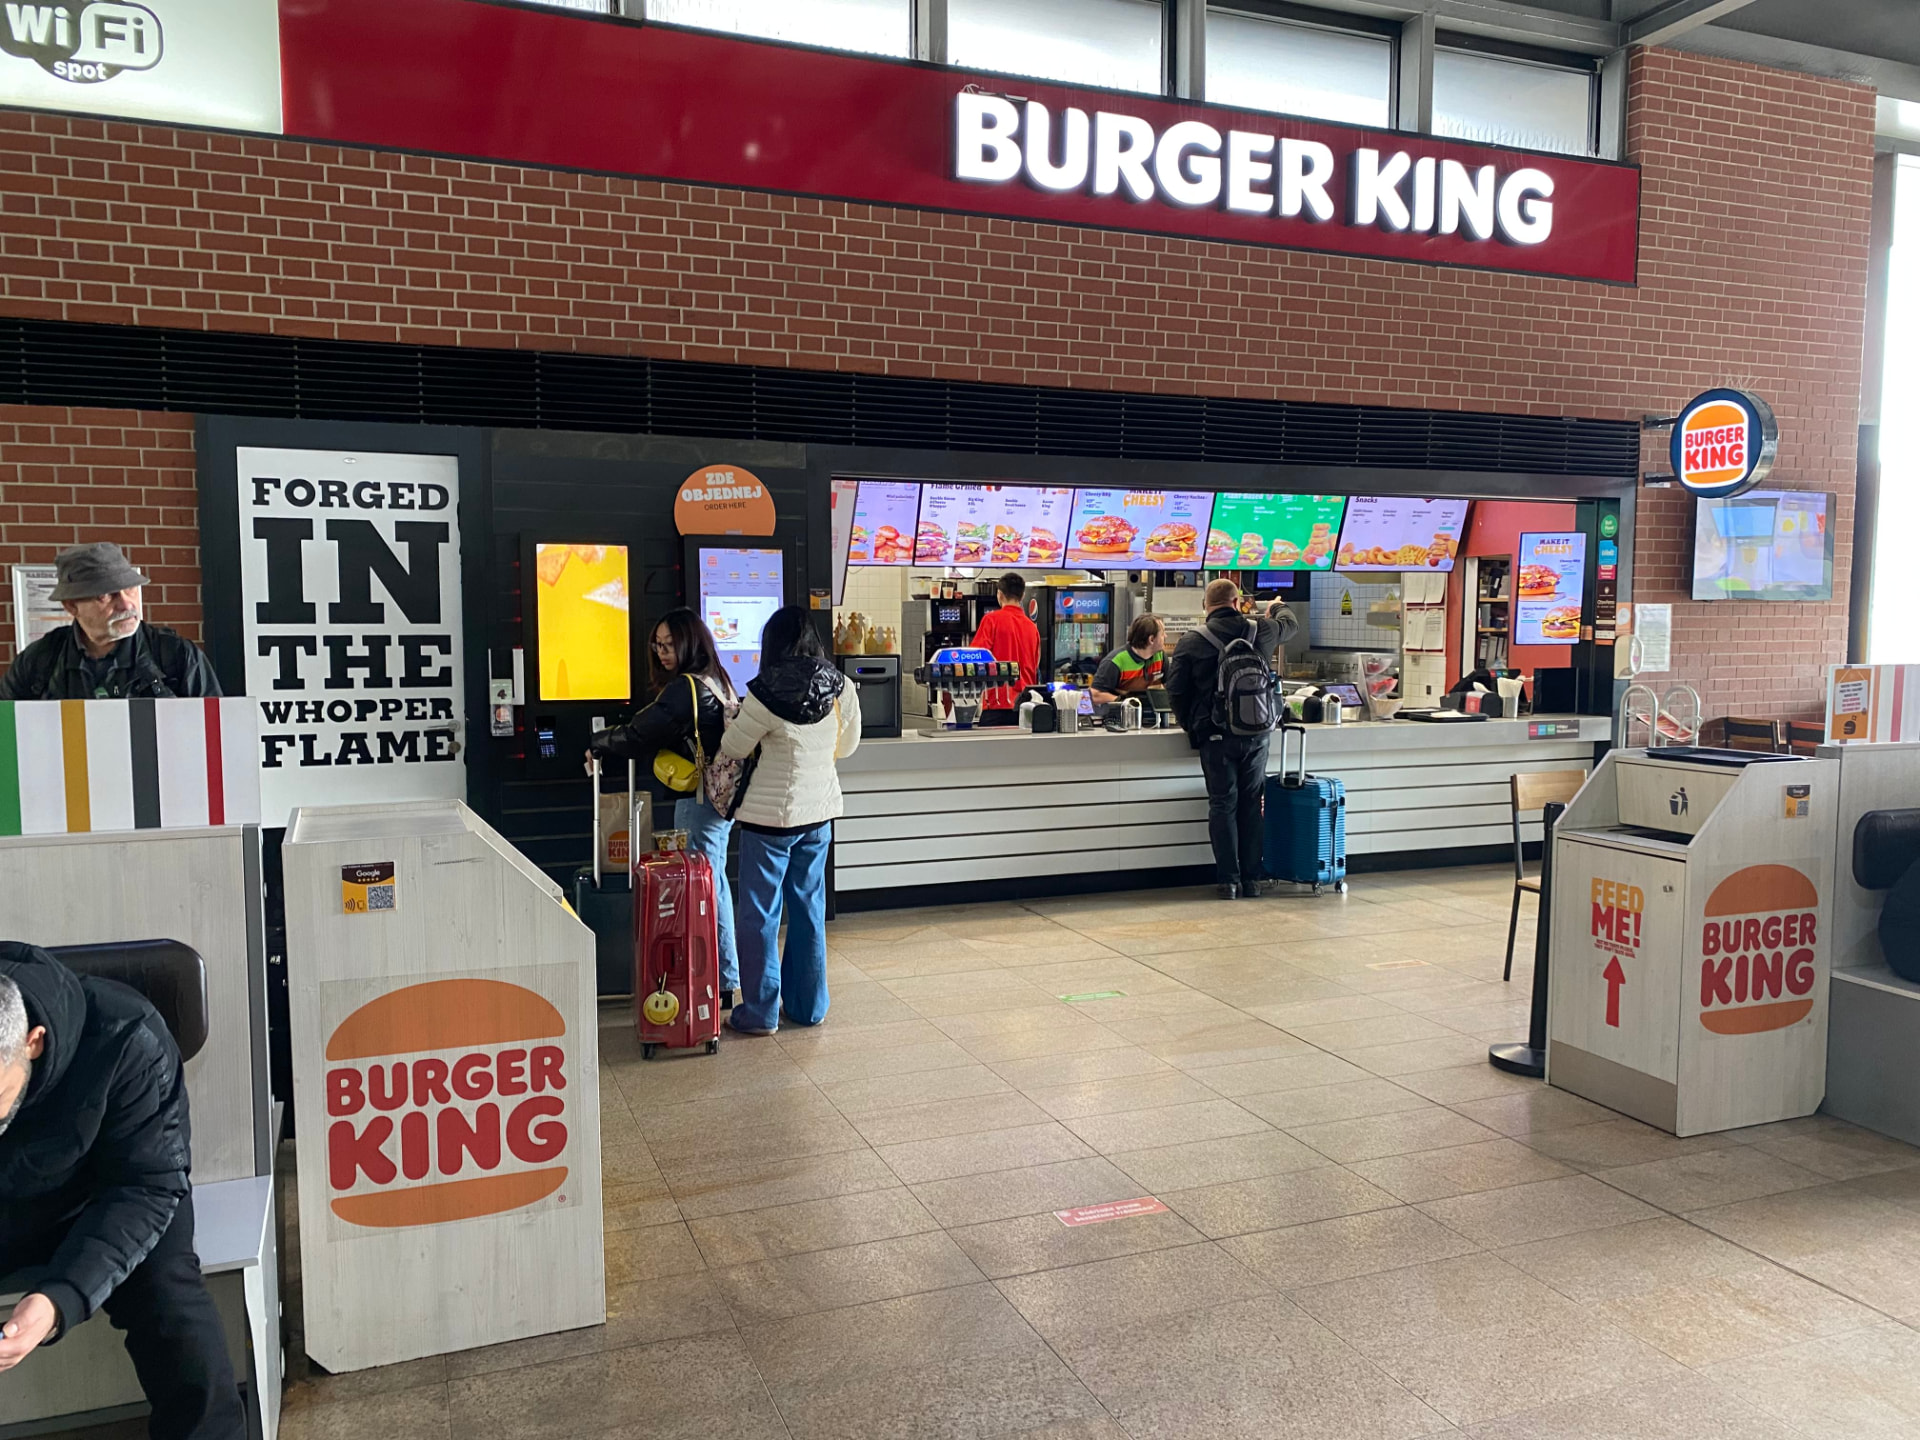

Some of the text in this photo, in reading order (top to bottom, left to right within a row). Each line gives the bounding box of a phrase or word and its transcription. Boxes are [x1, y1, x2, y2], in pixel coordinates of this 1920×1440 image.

[5, 3, 145, 54] Wi Fi
[54, 60, 107, 80] spot
[955, 92, 1555, 246] BURGER KING
[1685, 426, 1744, 449] BURGER
[1685, 443, 1744, 471] KING
[705, 472, 735, 485] ZDE
[252, 477, 449, 510] FORGED
[682, 485, 762, 502] OBJEDNEJ
[704, 502, 727, 511] ORDER
[1123, 494, 1166, 508] CHEESY
[253, 517, 450, 625] IN
[1076, 598, 1100, 608] pepsi
[257, 634, 452, 690] THE
[961, 652, 982, 660] pepsi
[260, 698, 454, 724] WHOPPER
[261, 730, 456, 768] FLAME
[608, 840, 629, 849] BURG
[608, 847, 629, 858] KIN
[356, 869, 380, 877] Google
[1591, 877, 1644, 913] FEED
[1591, 902, 1641, 948] ME!
[1702, 913, 1817, 956] BURGER
[1700, 948, 1815, 1007] KING
[326, 1045, 567, 1117] BURGER
[328, 1095, 568, 1190] KING
